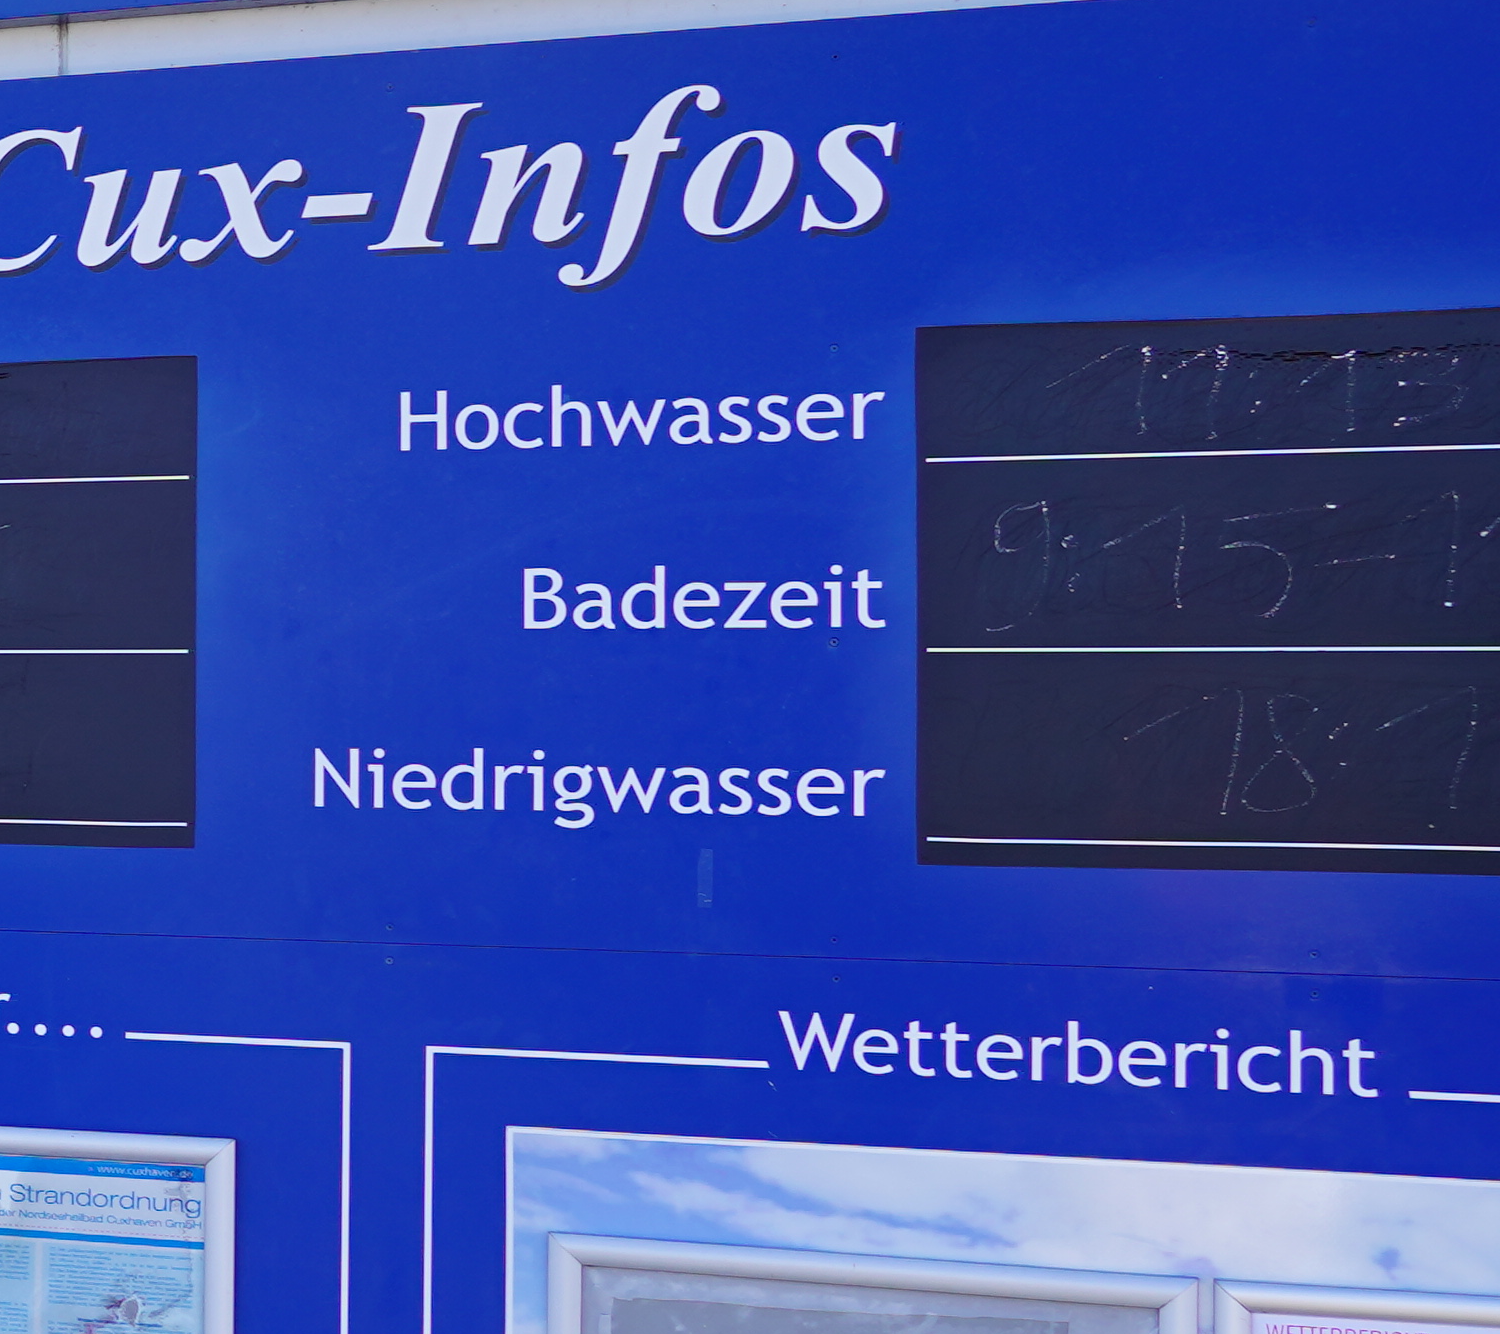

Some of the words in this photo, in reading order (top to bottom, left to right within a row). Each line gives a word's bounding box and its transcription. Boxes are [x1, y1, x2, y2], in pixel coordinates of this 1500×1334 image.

[399, 384, 886, 452] Hochwasser
[523, 564, 887, 630] Badezeit
[314, 747, 886, 829] Niedrigwasser
[778, 1010, 1379, 1098] Wetterbericht
[9, 1182, 202, 1218] Strandordnung
[106, 1215, 162, 1227] Cuxhaven
